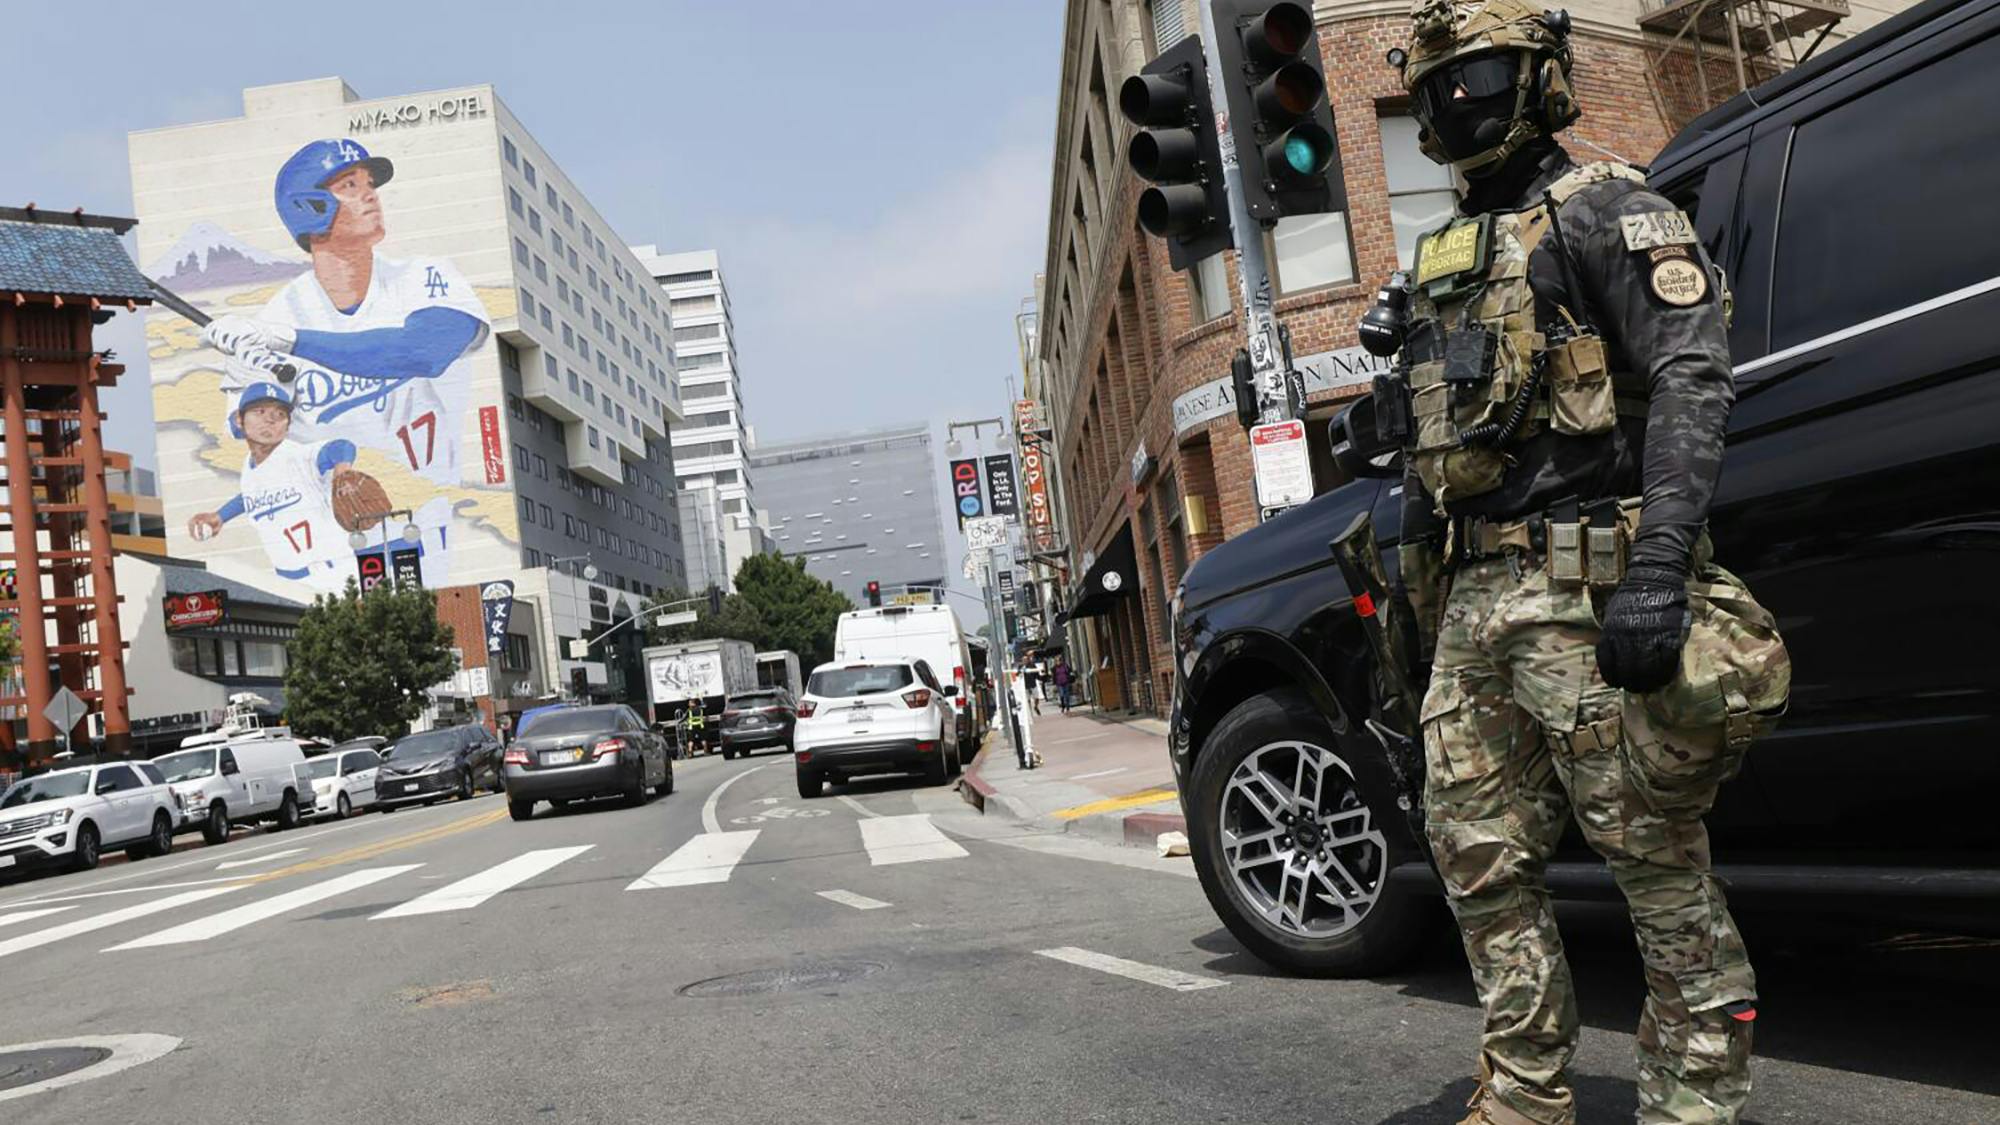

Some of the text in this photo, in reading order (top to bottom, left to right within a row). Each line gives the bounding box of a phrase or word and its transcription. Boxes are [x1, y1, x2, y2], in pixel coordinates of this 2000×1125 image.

[349, 96, 487, 133] MIYAKO HOTEL
[336, 140, 361, 162] LA
[1421, 227, 1475, 258] POLICE
[424, 265, 449, 298] LA
[396, 410, 437, 471] 17
[242, 487, 302, 521] Dodgers
[283, 520, 313, 554] 17
